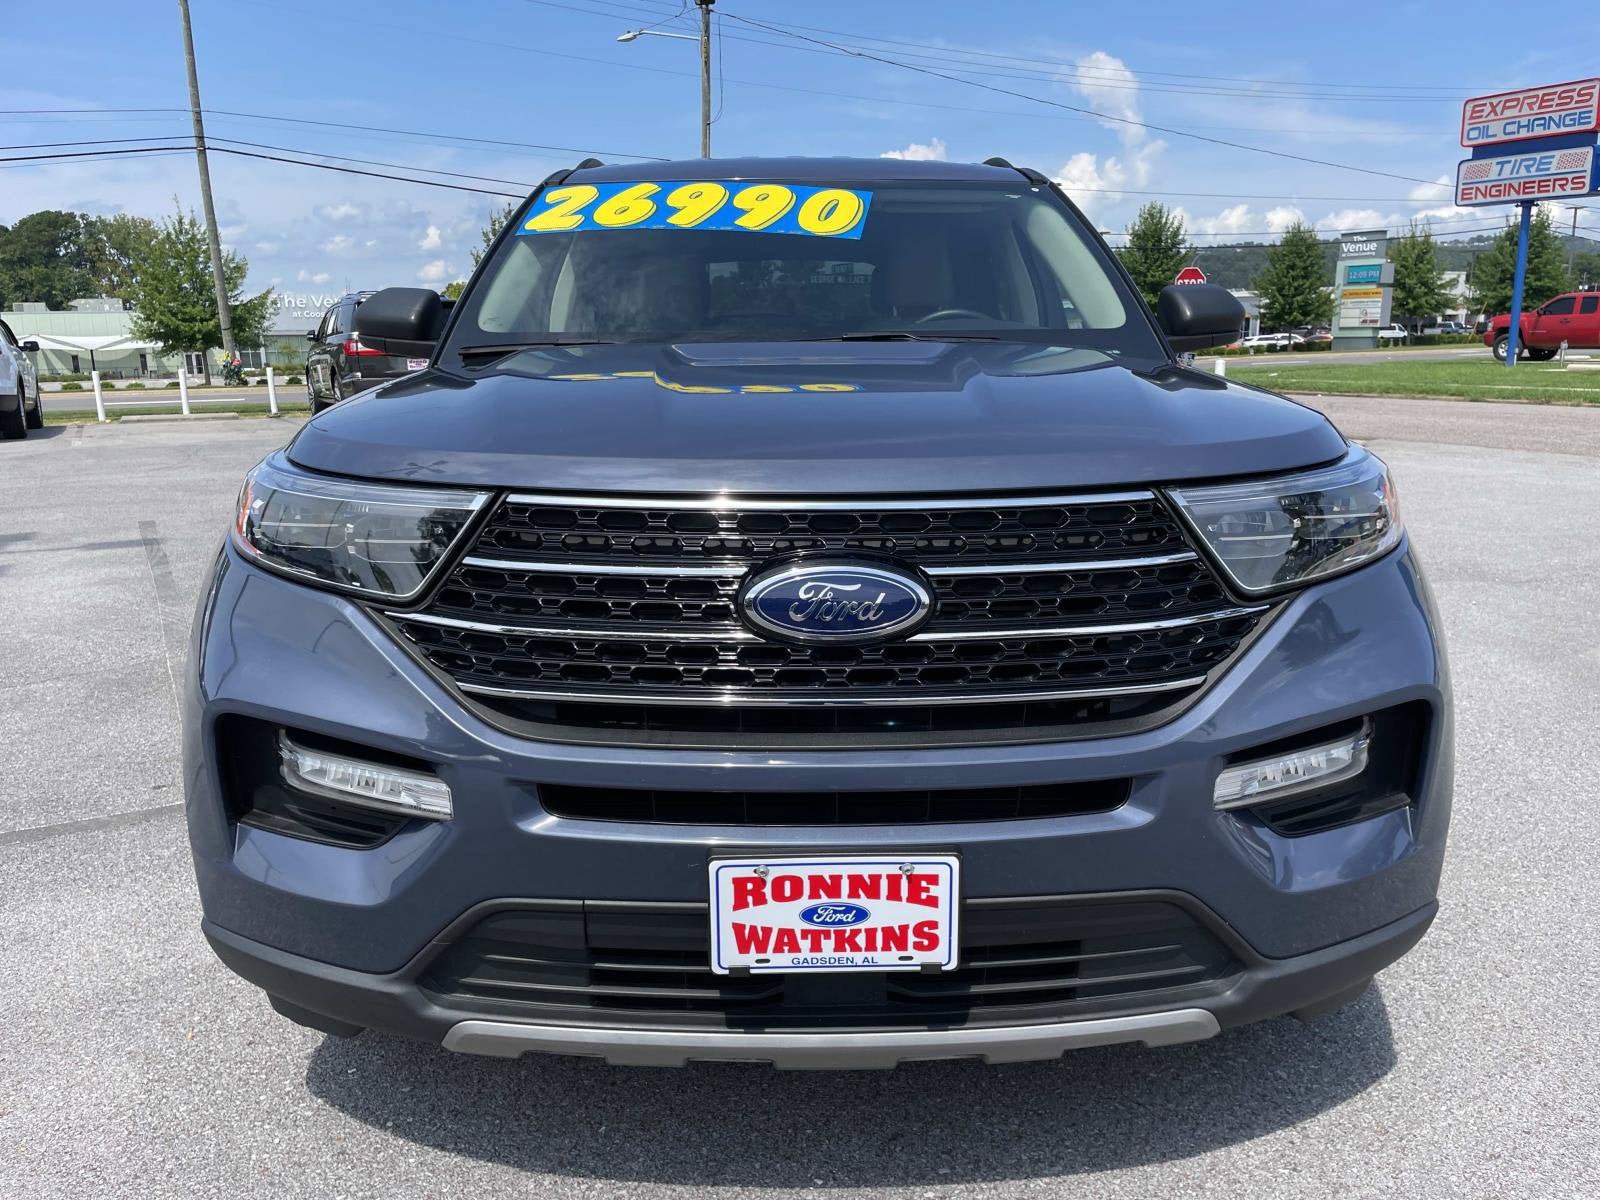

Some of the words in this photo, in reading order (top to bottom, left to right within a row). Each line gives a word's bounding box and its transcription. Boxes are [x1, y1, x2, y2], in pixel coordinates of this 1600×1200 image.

[1468, 85, 1597, 121] EXPRESS
[1467, 125, 1498, 141] OIL
[1503, 110, 1593, 136] CHANGE
[1496, 155, 1556, 176] TIRE
[1461, 175, 1587, 201] ENGINEERS
[524, 182, 864, 235] 26990
[1342, 242, 1378, 252] Venue
[789, 581, 886, 622] Ford
[731, 874, 940, 912] RONNIE
[813, 905, 857, 923] Ford
[732, 920, 940, 955] WATKINS
[791, 957, 858, 967] GADSDEN,
[862, 956, 879, 965] AL
